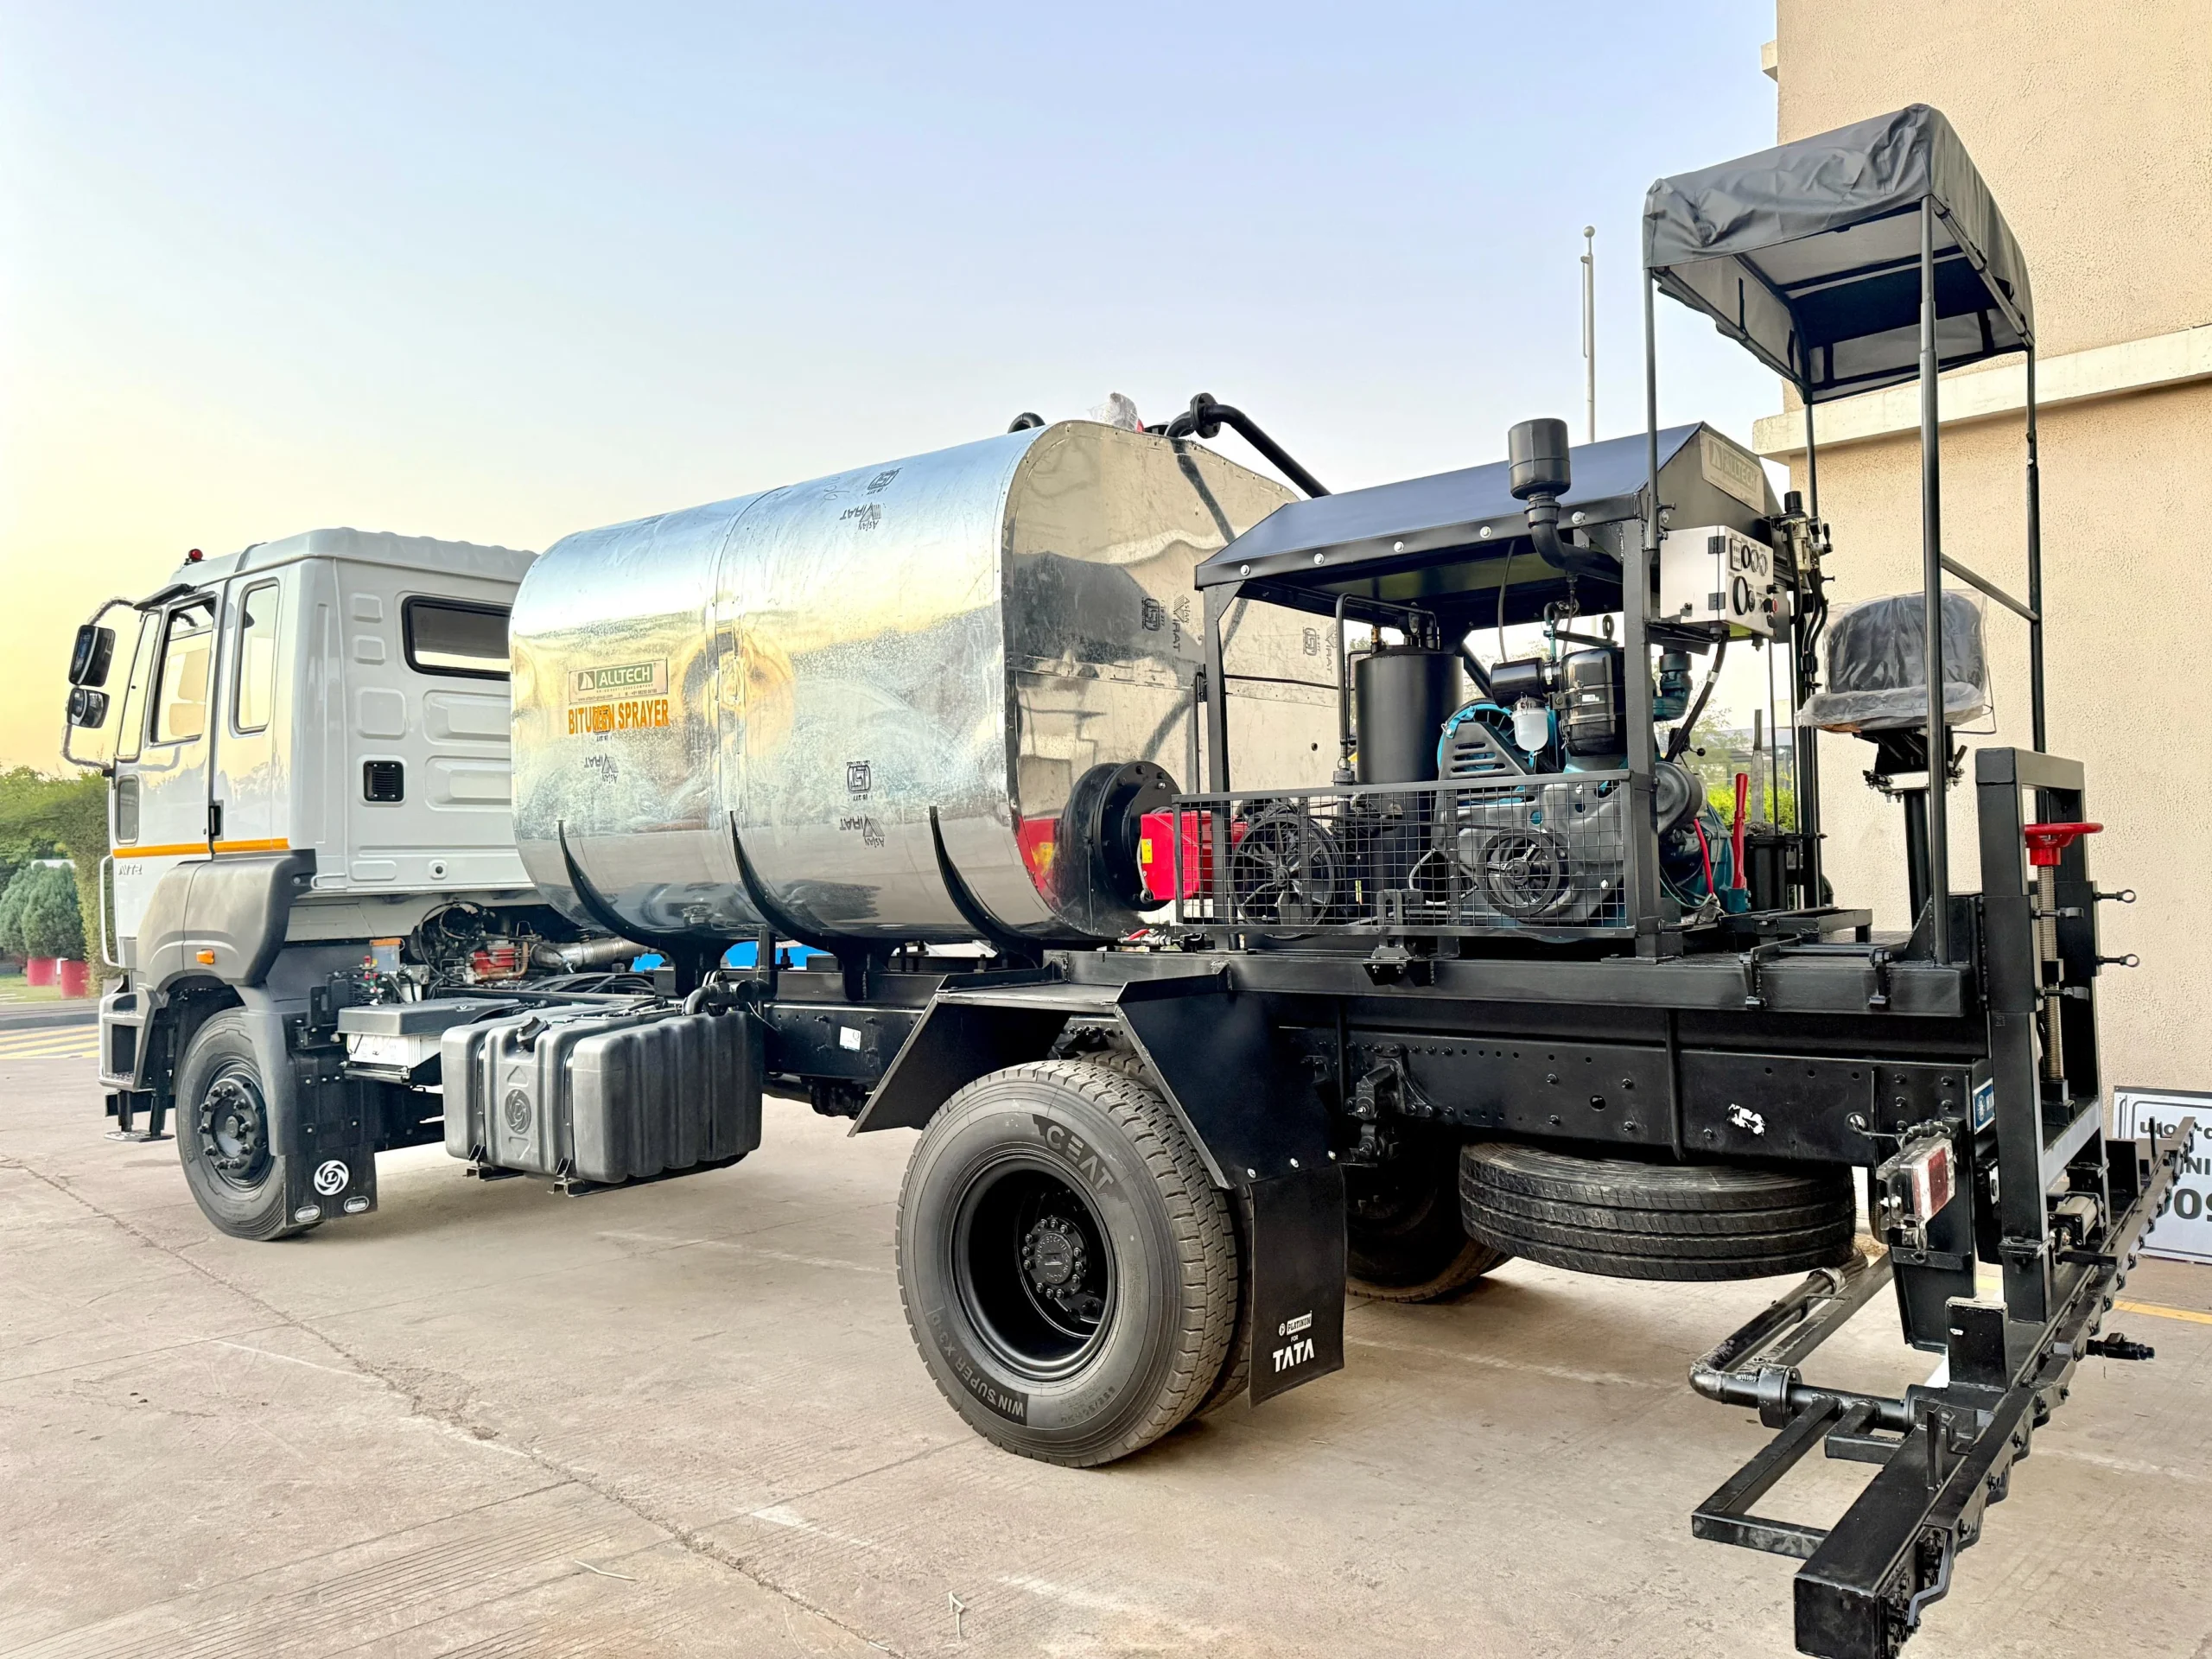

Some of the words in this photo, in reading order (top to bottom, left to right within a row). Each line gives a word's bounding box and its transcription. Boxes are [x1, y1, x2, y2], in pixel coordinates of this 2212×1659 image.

[839, 503, 882, 522] VIRAT
[1173, 594, 1185, 652] VIRAT
[1325, 623, 1334, 674] VIRAT
[599, 666, 651, 687] ALLTECH
[618, 699, 670, 729] SPRAYER
[584, 753, 619, 773] VIRAT
[839, 814, 885, 836] VIRAT
[1046, 1125, 1115, 1191] CEAT
[1287, 1316, 1312, 1332] PLATINUM
[1273, 1338, 1315, 1373] TATA
[955, 1357, 997, 1406] SUPER
[998, 1394, 1025, 1418] WIN
